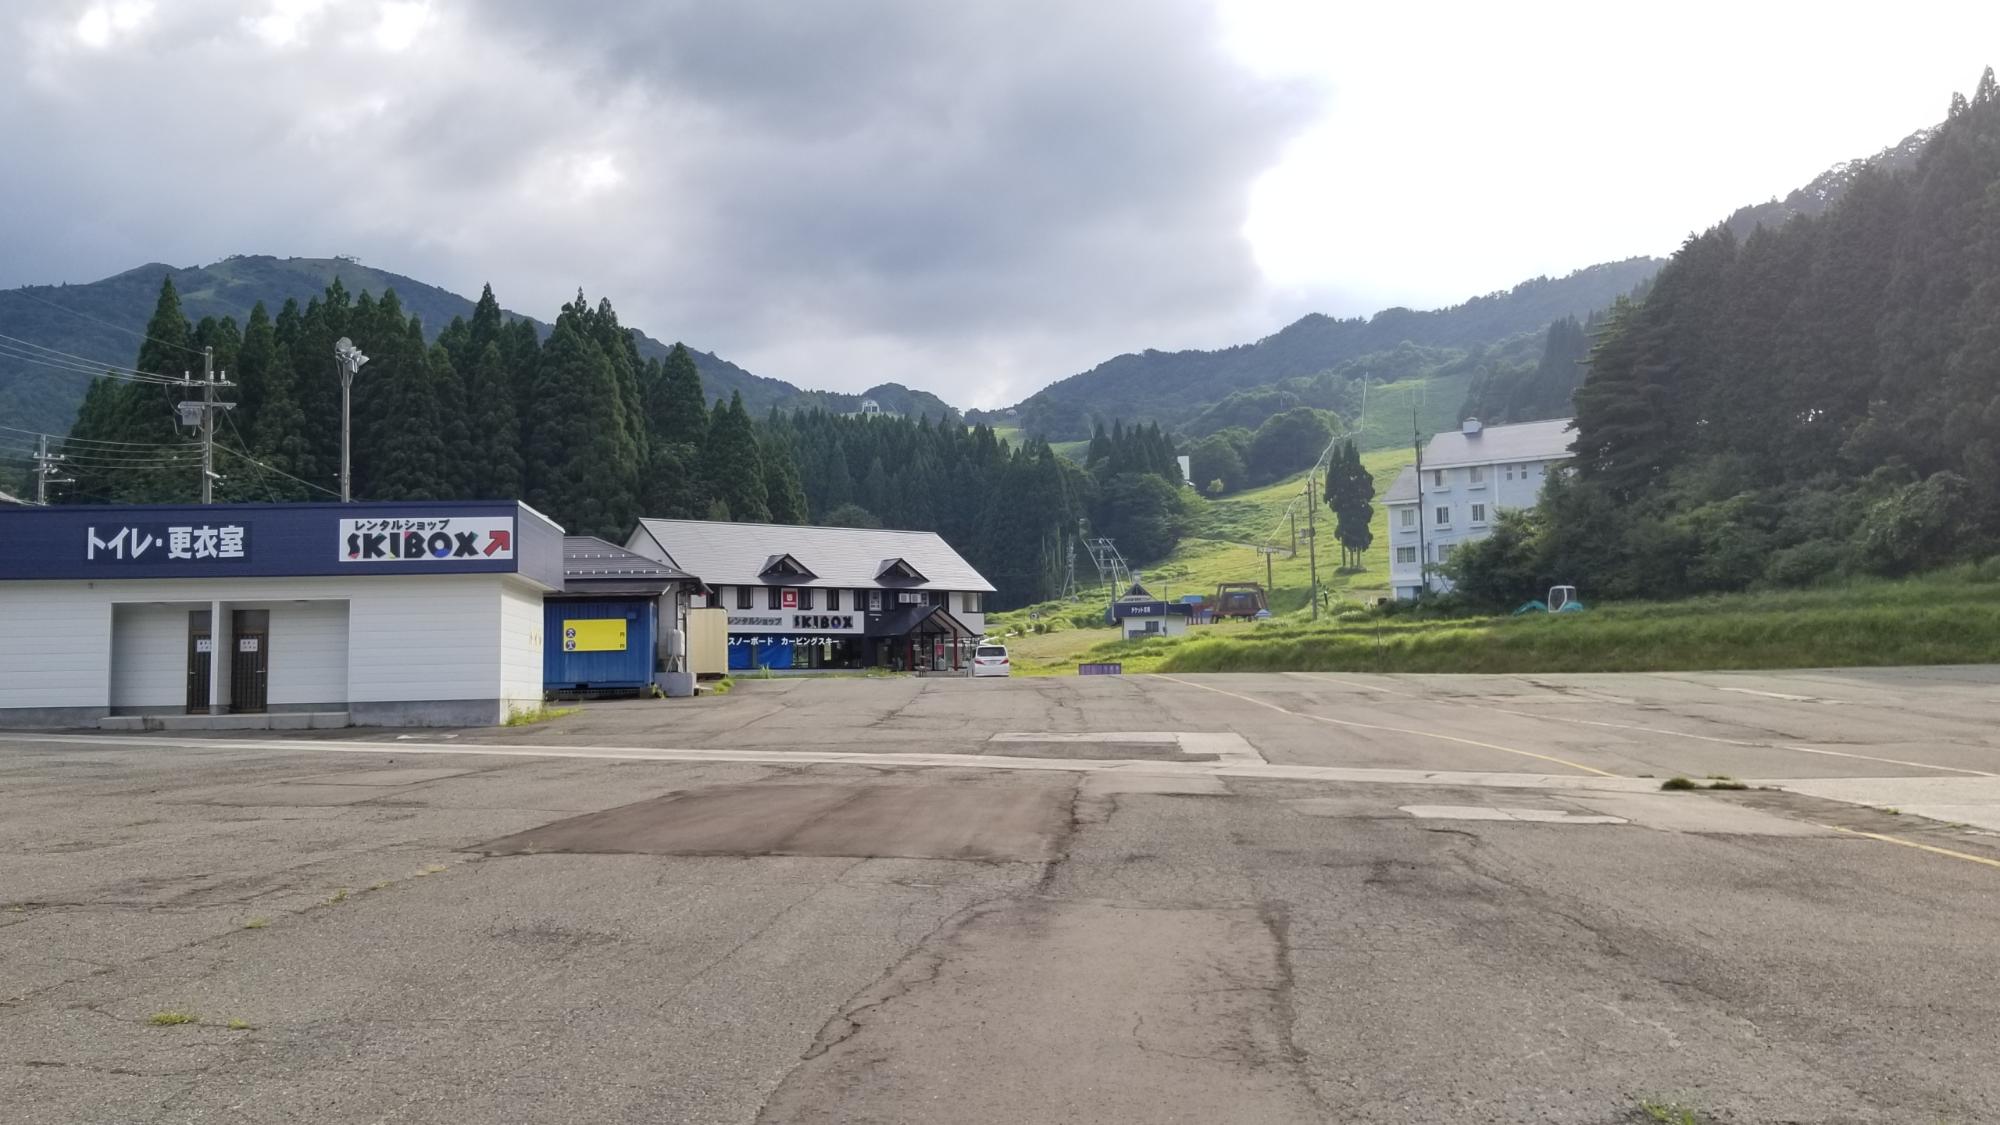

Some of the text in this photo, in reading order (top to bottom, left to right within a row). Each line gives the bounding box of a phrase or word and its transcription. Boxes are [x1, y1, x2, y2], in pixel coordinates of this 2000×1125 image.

[355, 519, 450, 531] レンタルショップ
[87, 525, 244, 560] トイレ・更衣室
[347, 531, 479, 559] SKIBOX
[728, 617, 782, 625] レンタルショップ
[794, 615, 853, 629] SKIBOX
[728, 636, 840, 646] スノーボード カービングスキー
